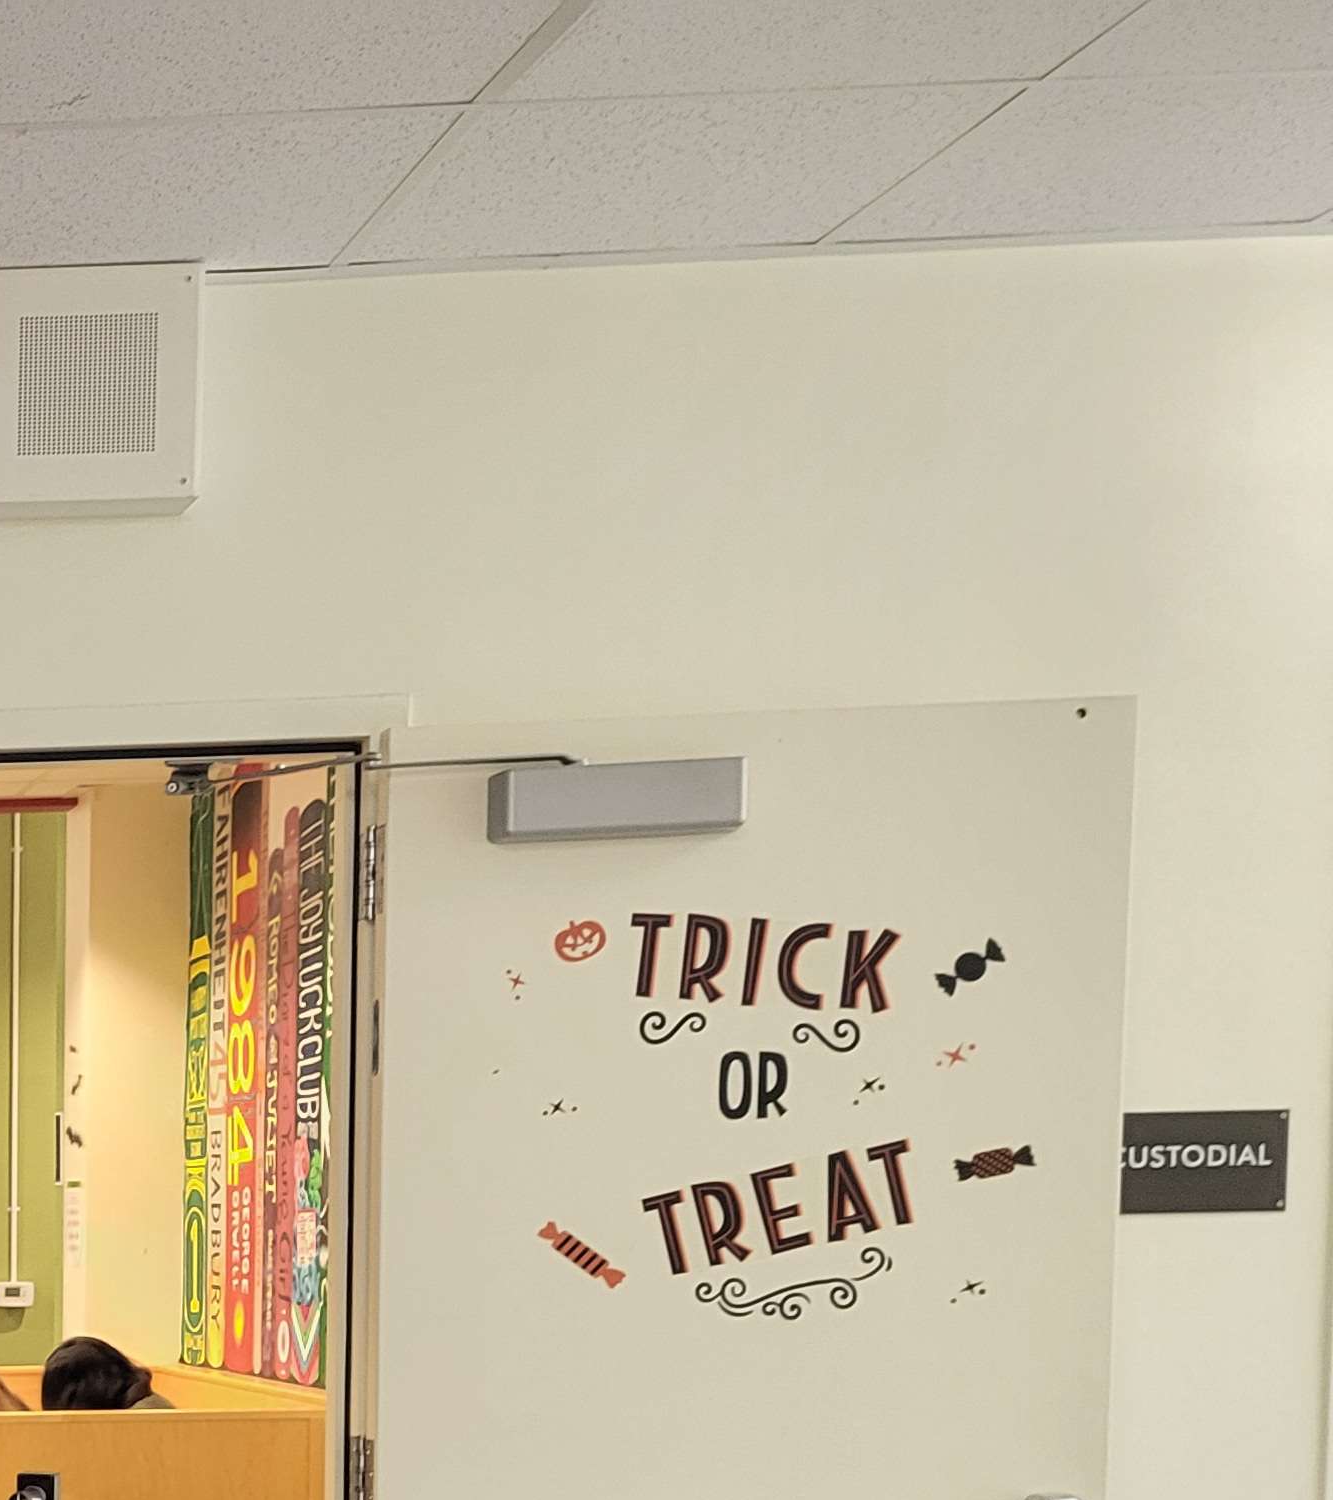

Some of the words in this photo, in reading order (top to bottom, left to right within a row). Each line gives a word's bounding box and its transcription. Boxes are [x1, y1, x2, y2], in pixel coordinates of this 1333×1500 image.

[300, 817, 325, 876] THE
[298, 887, 324, 945] JOY
[630, 912, 901, 1014] TRICK
[227, 850, 259, 1186] 1984
[267, 914, 282, 1026] ROMEO
[298, 945, 324, 1034] LUCK
[297, 1035, 323, 1122] CLUB
[718, 1050, 789, 1120] OR
[208, 1128, 222, 1331] BRADBURY
[231, 1190, 241, 1292] ORWELL
[241, 1186, 251, 1295] GEORGE
[642, 1138, 916, 1276] TREAT
